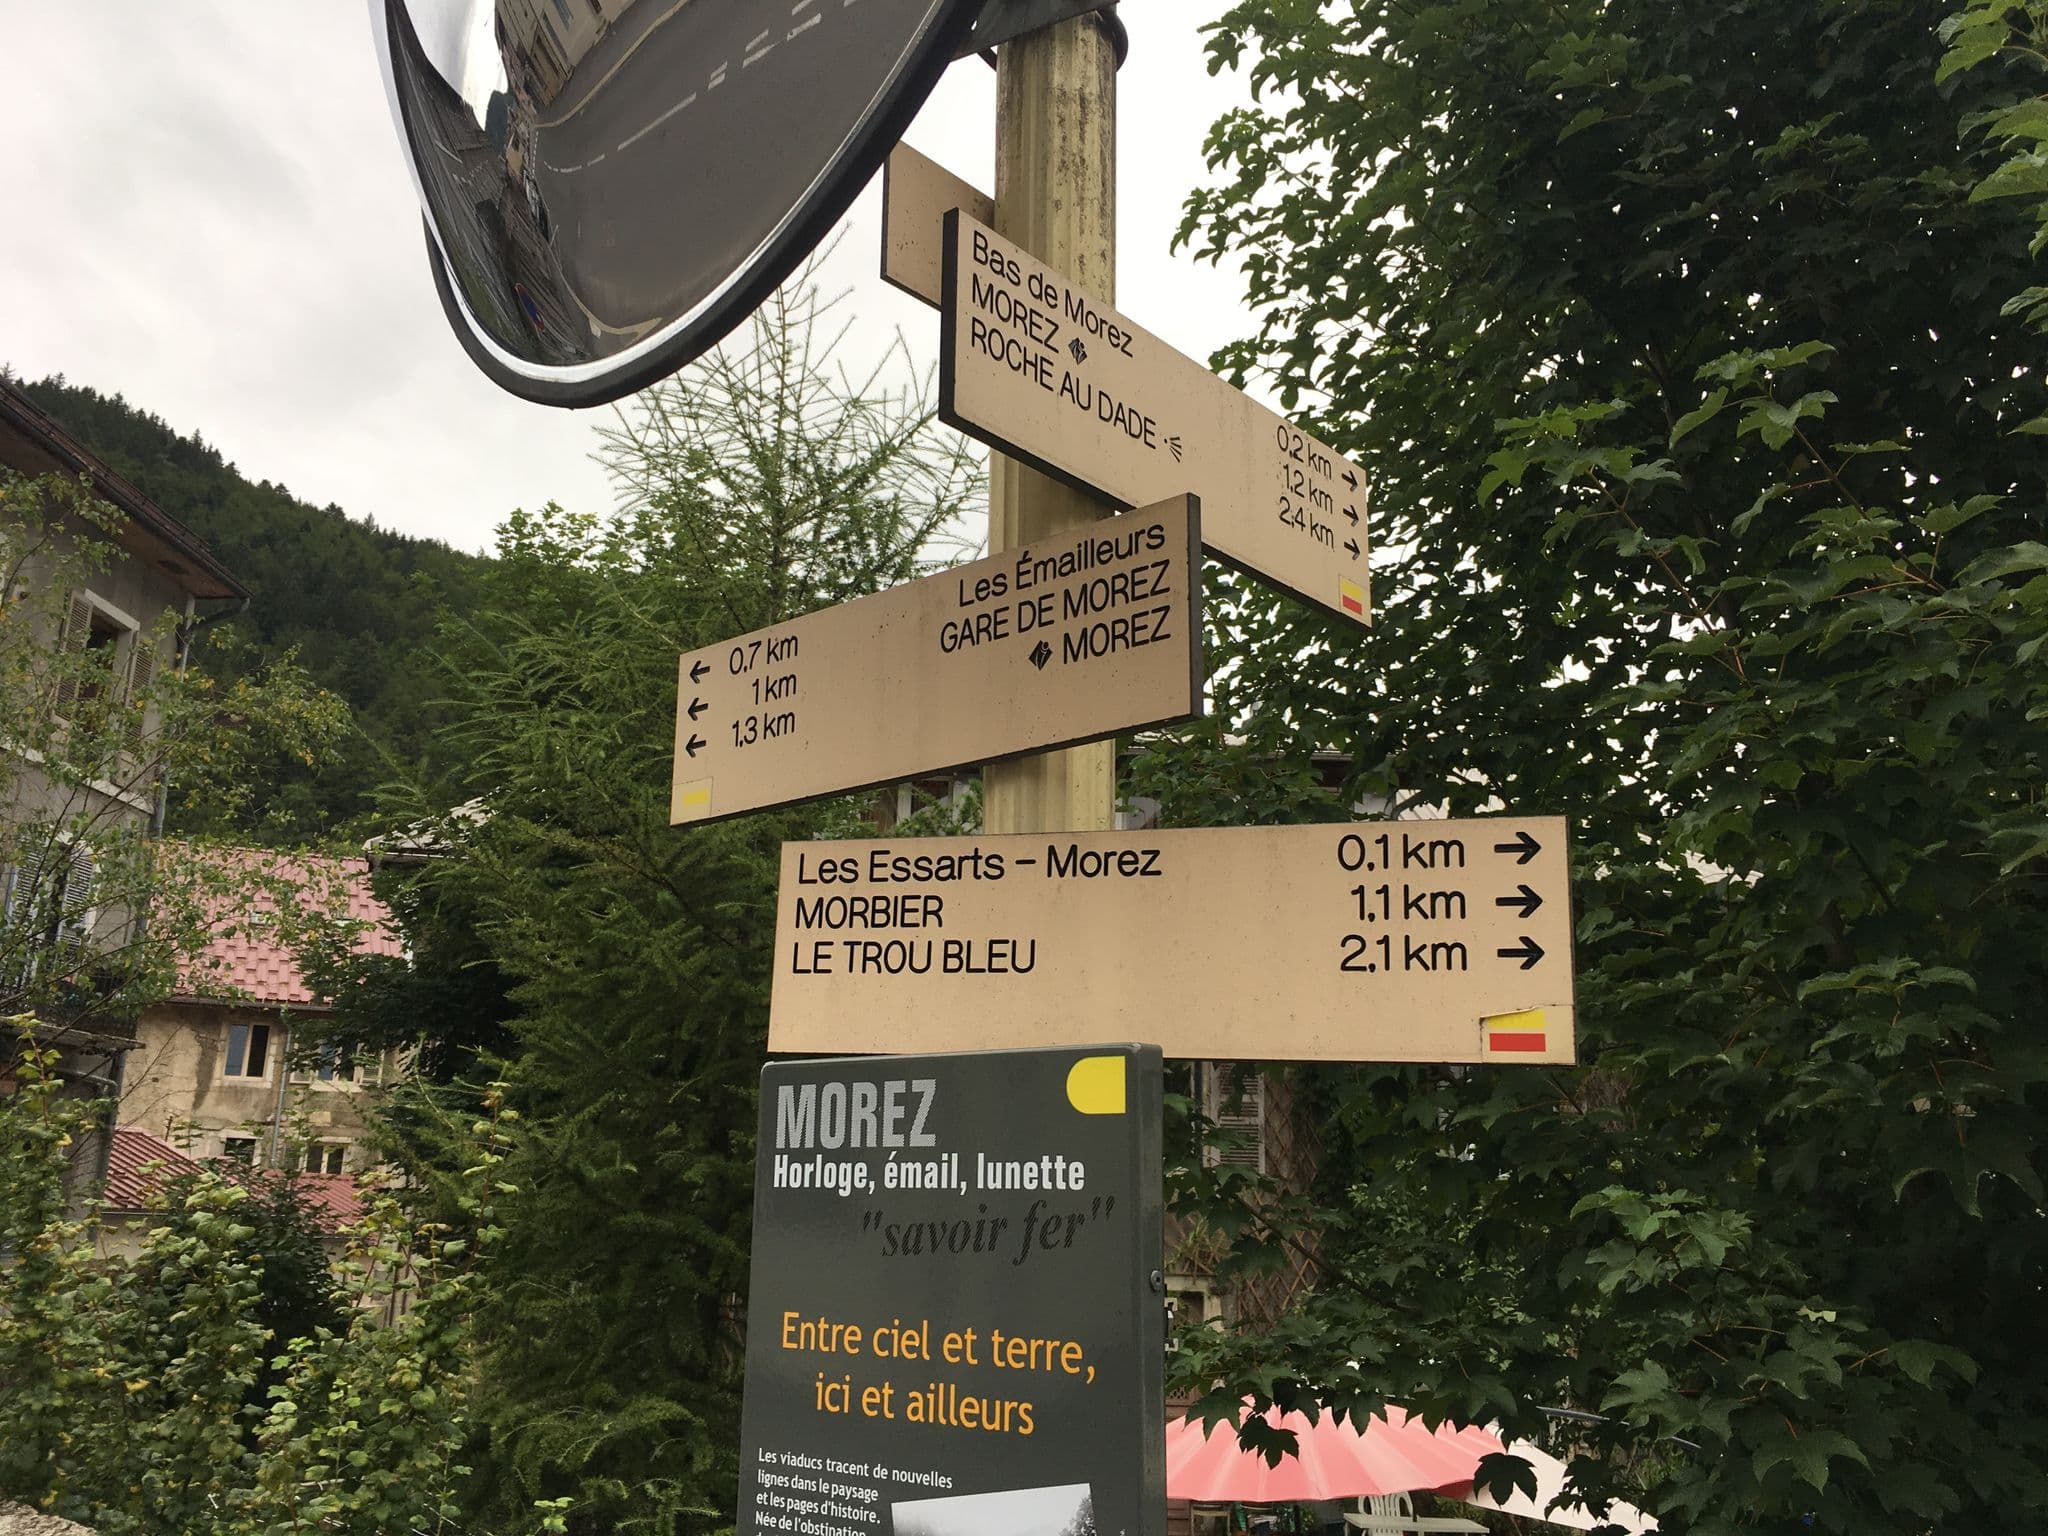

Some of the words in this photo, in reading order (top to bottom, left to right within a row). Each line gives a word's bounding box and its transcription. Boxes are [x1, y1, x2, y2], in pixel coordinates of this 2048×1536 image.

[974, 230, 1021, 288] Bas
[1028, 272, 1058, 310] de
[1065, 288, 1134, 357] Morez
[972, 273, 1059, 354] MOREZ
[971, 316, 1054, 392] ROCHE
[1060, 370, 1092, 411] AU
[1099, 391, 1157, 449] DADE
[1308, 443, 1331, 480] km
[1309, 478, 1333, 514] km
[1310, 512, 1334, 549] km
[959, 575, 1008, 608] Les
[1016, 523, 1166, 591] Émailleurs
[940, 606, 1009, 654] GARE
[1018, 593, 1055, 634] DE
[1063, 559, 1171, 619] MOREZ
[766, 635, 798, 664] km
[1063, 605, 1171, 665] MOREZ
[752, 678, 759, 705] 1
[765, 674, 797, 702] km
[763, 711, 795, 740] km
[798, 853, 859, 884] Les
[869, 848, 1005, 882] Essarts
[1047, 844, 1162, 878] Morez
[1403, 833, 1465, 869] km
[795, 895, 943, 929] MORBIER
[1404, 884, 1466, 920] km
[792, 941, 834, 974] LE
[843, 940, 932, 974] TROU
[943, 939, 1036, 974] BLEU
[1404, 934, 1467, 971] km
[775, 1078, 937, 1149] MOREZ
[773, 1153, 875, 1197] Horloge,
[884, 1151, 967, 1195] émail,
[977, 1153, 1085, 1191] lunette
[782, 1311, 862, 1355] Entre
[872, 1319, 930, 1361] ciel
[942, 1327, 978, 1365] et
[992, 1328, 1096, 1385] terre,
[815, 1372, 850, 1413] ici
[861, 1380, 894, 1419] et
[906, 1383, 1034, 1435] ailleurs
[757, 1469, 789, 1488] lignes
[791, 1475, 817, 1492] dans
[819, 1479, 829, 1493] le
[831, 1483, 878, 1504] paysage
[758, 1447, 777, 1464] Les
[780, 1451, 823, 1470] viaducs
[826, 1458, 869, 1477] tracent
[873, 1464, 888, 1479] de
[892, 1469, 953, 1489] nouvelles
[755, 1510, 776, 1528] Née
[778, 1515, 792, 1530] de
[756, 1492, 768, 1505] et
[769, 1492, 785, 1508] les
[786, 1498, 818, 1515] pages
[821, 1501, 881, 1524] d'histoire.
